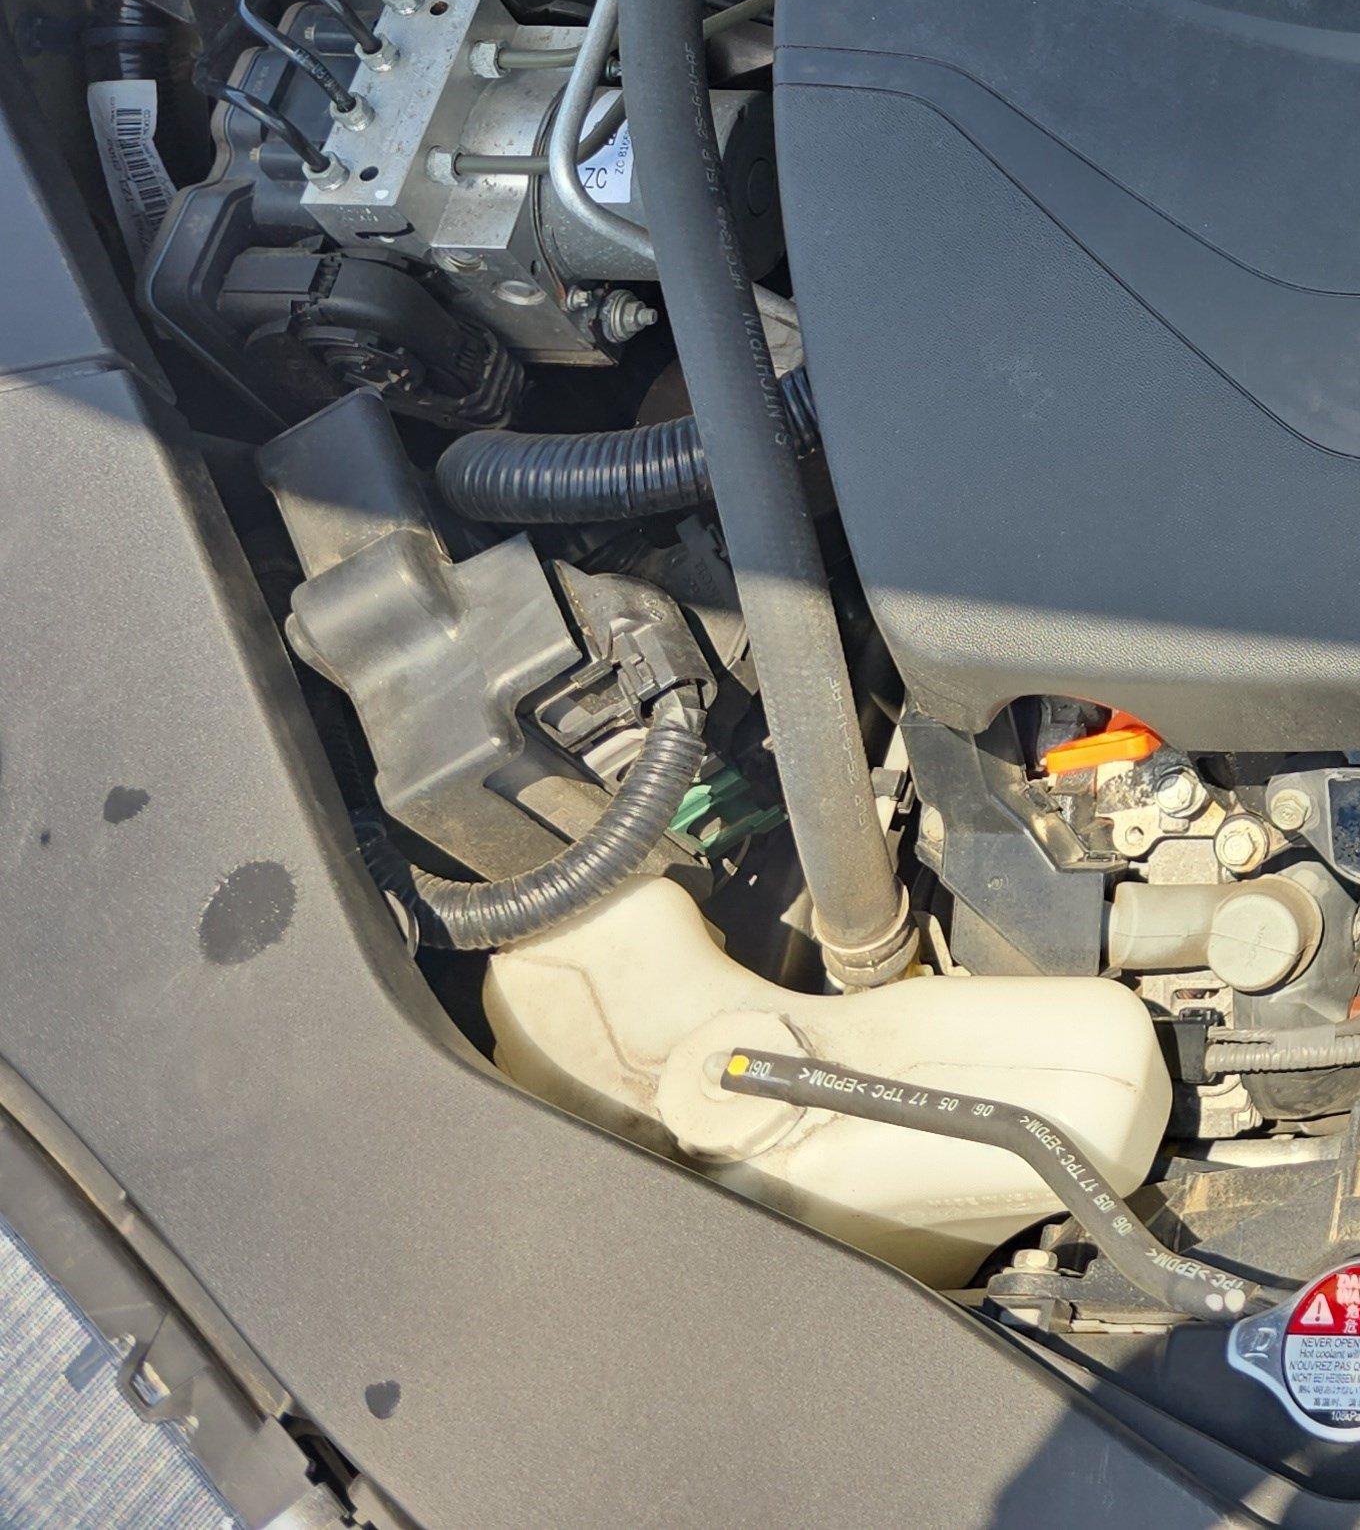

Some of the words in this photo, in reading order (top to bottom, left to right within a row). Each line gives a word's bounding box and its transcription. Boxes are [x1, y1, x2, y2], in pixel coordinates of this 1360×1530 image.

[583, 167, 608, 189] ZC
[799, 1067, 868, 1094] >EPDM<
[871, 1084, 904, 1102] TPC
[909, 1092, 928, 1106] 17
[937, 1096, 960, 1112] 05
[1019, 1115, 1066, 1155] >EPDM<
[1060, 1154, 1086, 1180] TPC
[1079, 1178, 1099, 1192] 17
[1144, 1248, 1211, 1281] >EPDM<
[1301, 1338, 1332, 1347] NEVER
[1335, 1338, 1360, 1348] OPEN
[1300, 1349, 1314, 1359] Hot
[1315, 1350, 1345, 1359] coolant
[1347, 1350, 1360, 1359] will
[1289, 1361, 1333, 1371] N'OUVREZ
[1334, 1361, 1351, 1371] PAS
